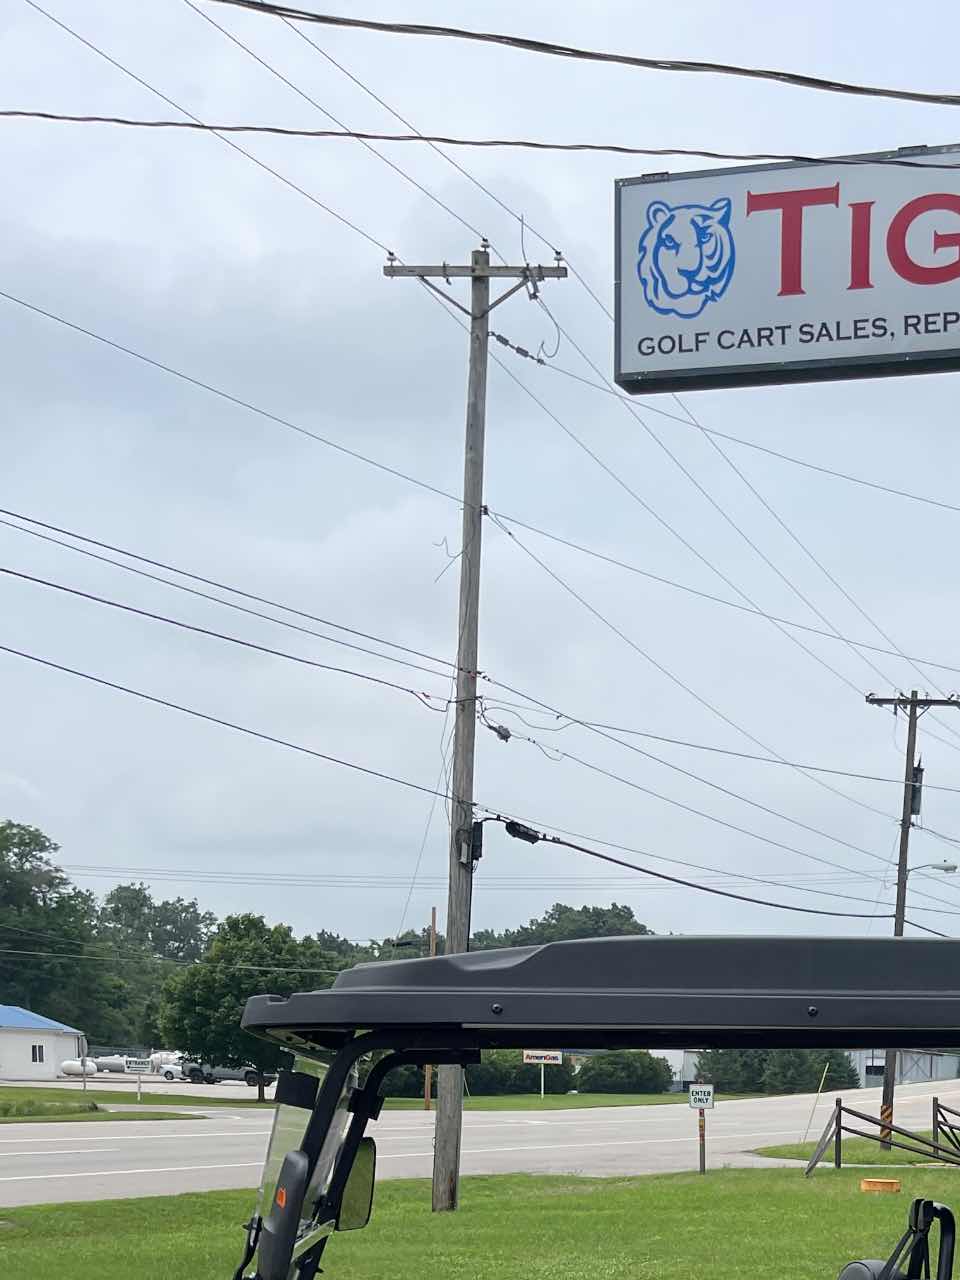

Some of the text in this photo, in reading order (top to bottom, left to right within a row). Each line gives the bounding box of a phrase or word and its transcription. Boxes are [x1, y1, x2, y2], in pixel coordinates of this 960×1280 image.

[638, 331, 709, 356] GOLF
[717, 325, 792, 350] CART
[799, 317, 895, 344] SALES,
